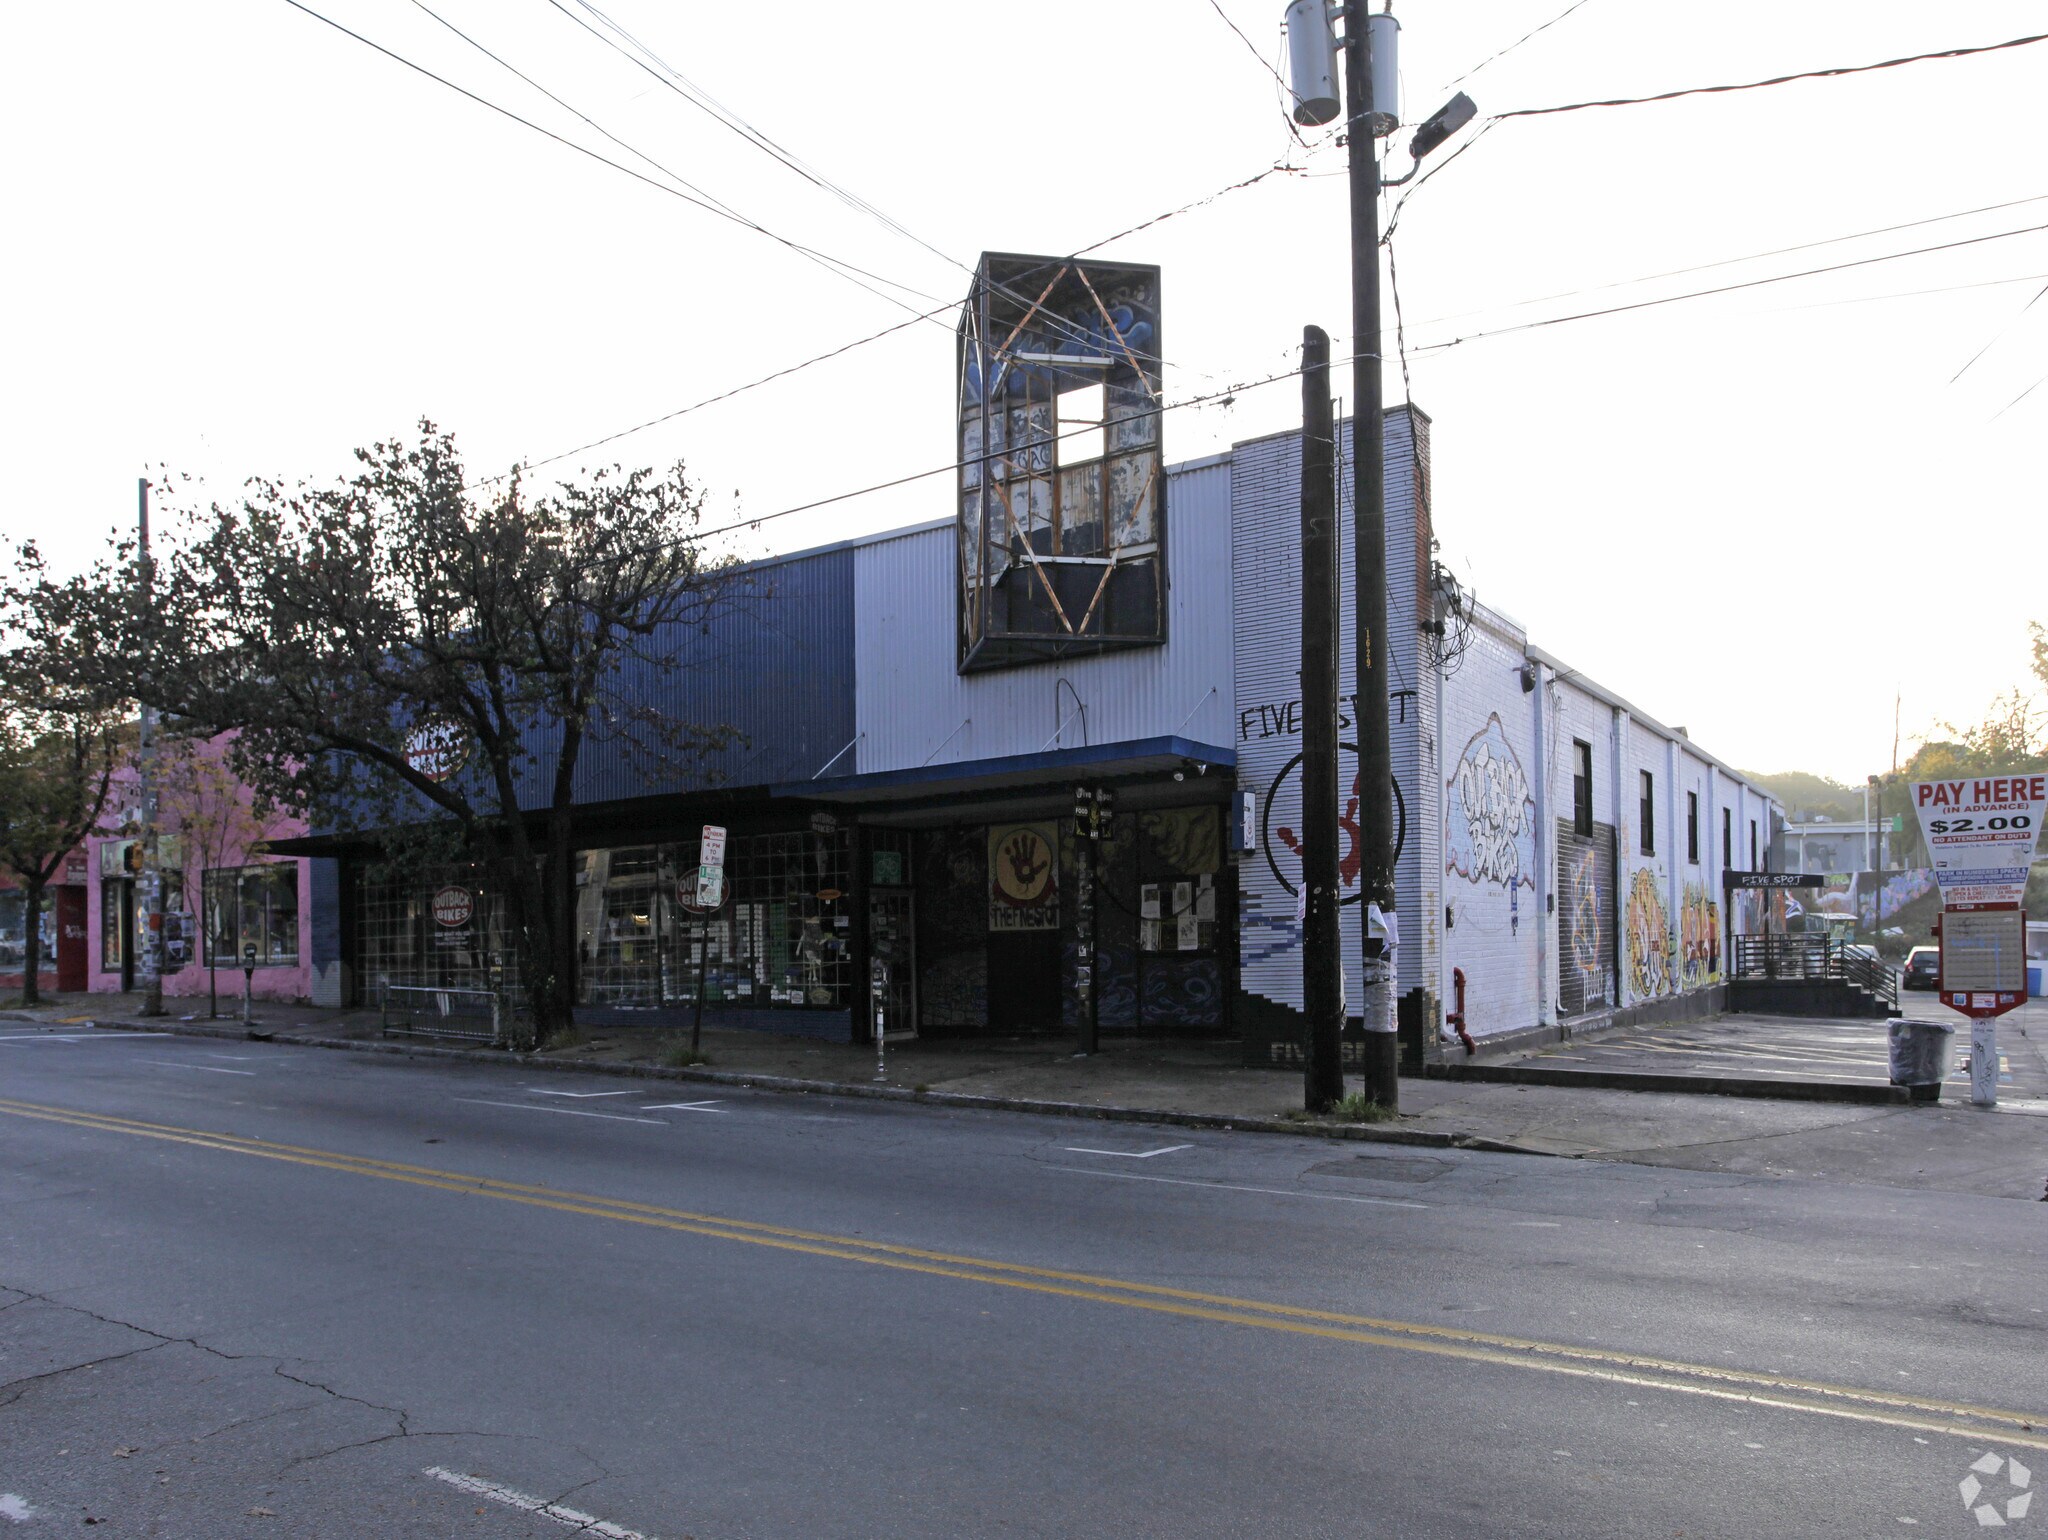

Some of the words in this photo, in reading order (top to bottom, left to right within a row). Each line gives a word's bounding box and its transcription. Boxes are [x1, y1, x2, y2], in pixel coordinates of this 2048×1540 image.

[1240, 701, 1303, 741] FIVE
[1918, 783, 1966, 807] PAY
[1973, 778, 2046, 803] HERE
[1942, 806, 1960, 815] (IN
[1963, 802, 2030, 813] ADVANCE)
[1929, 819, 2031, 834] $2.00
[1933, 836, 1945, 844] NO
[1946, 834, 1993, 843] ATTENDANT
[1994, 833, 2008, 841] ON
[2007, 831, 2030, 840] DUTY
[1742, 875, 1770, 884] FIVE
[1773, 875, 1804, 884] SPOT
[435, 890, 470, 909] OUTBACK
[437, 907, 469, 922] BIKES
[1270, 1041, 1306, 1063] FIV
